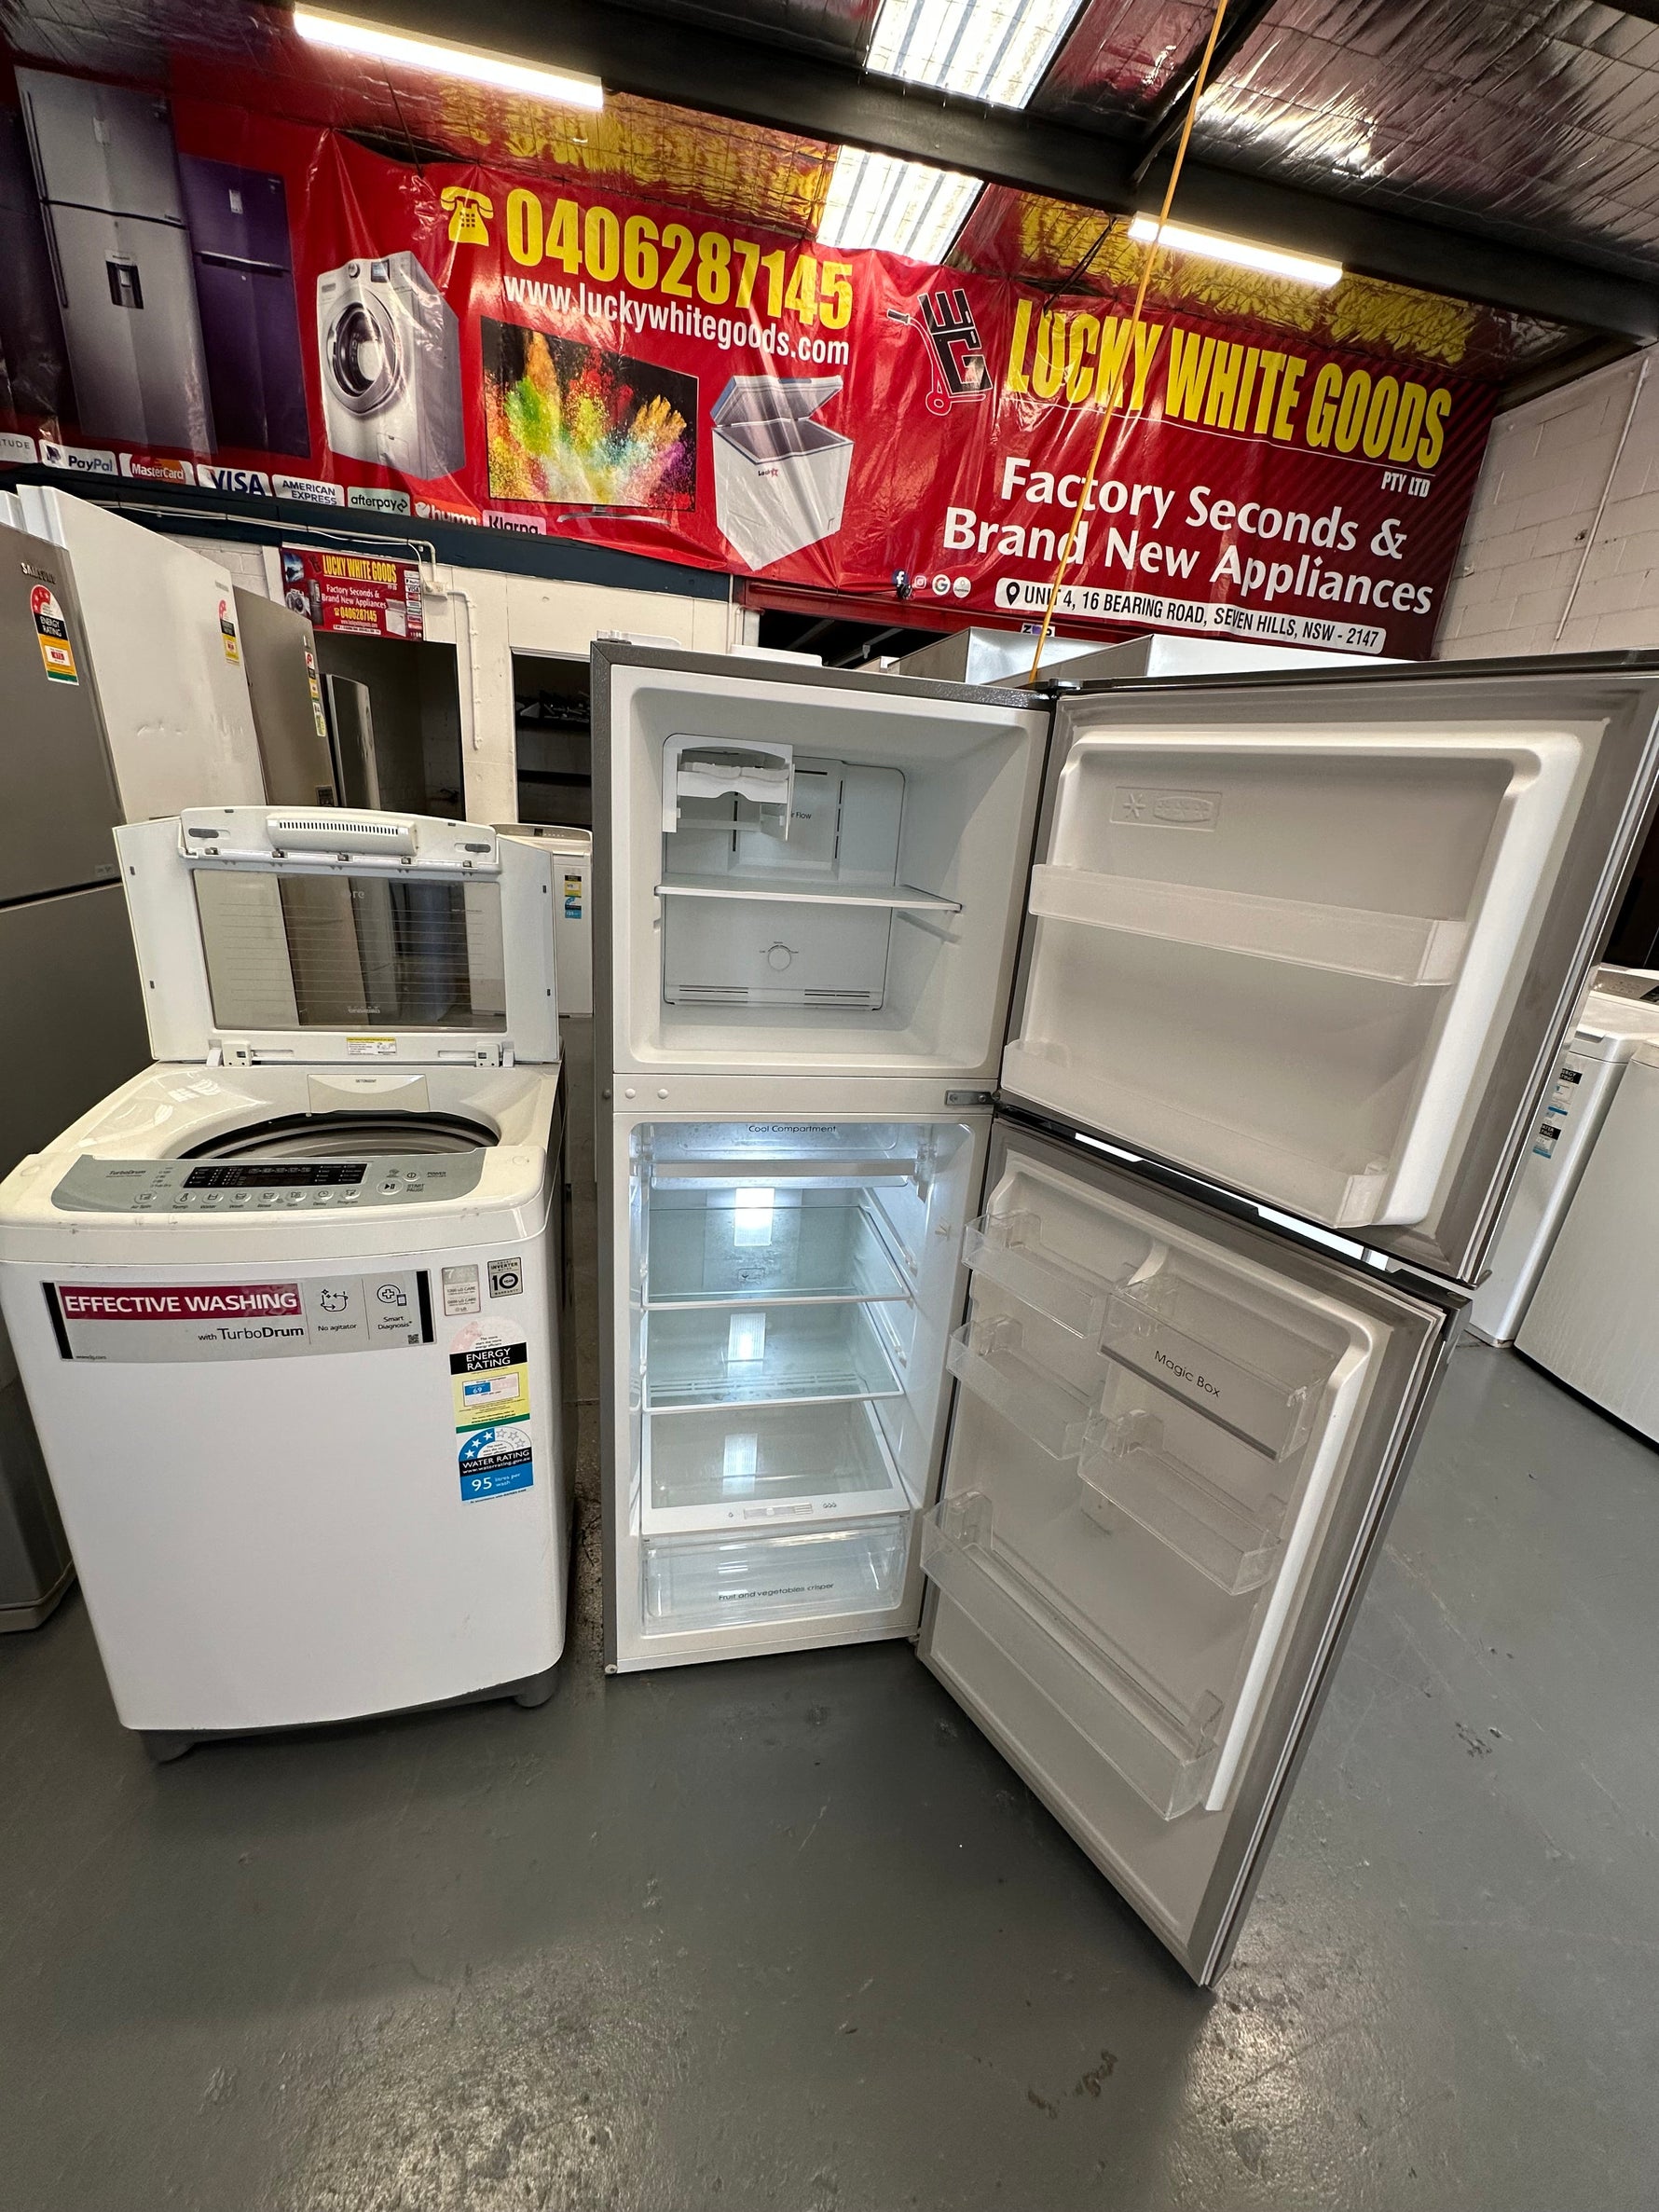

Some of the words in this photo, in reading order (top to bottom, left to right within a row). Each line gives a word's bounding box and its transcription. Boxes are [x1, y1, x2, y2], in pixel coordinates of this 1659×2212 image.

[506, 188, 853, 330] 0406287145
[503, 275, 850, 365] www.luckywhitegoods.com
[1006, 298, 1164, 411] LUCKY
[1165, 327, 1307, 441] WHITE
[1306, 363, 1451, 469] GOODS
[0, 438, 30, 449] TUDE
[68, 455, 113, 472] PayPal
[131, 463, 185, 480] MasterCard
[211, 470, 267, 495] VISA
[281, 479, 336, 496] AMERICAN
[1381, 471, 1406, 492] PTY
[1407, 476, 1431, 498] LTD
[291, 490, 337, 505] EXPRESS
[350, 495, 397, 512] afterpay
[430, 503, 477, 526] humm
[1001, 456, 1175, 529] Factory
[1186, 486, 1359, 551] Seconds
[1370, 518, 1407, 559] &
[943, 506, 1089, 565] Brand
[1104, 527, 1200, 580] New
[1209, 544, 1433, 614] Appliances
[322, 555, 346, 576] LUCKY
[347, 557, 372, 580] WHITE
[372, 561, 397, 584] GOODS
[326, 584, 349, 597] Factory
[350, 587, 374, 598] Seconds
[322, 593, 340, 603] Brand
[341, 596, 354, 605] New
[355, 598, 387, 610] Appliances
[340, 606, 377, 622] 0406287145
[1063, 590, 1076, 611] 4,
[1083, 591, 1100, 610] 16
[1104, 595, 1163, 618] BEARING
[1167, 602, 1208, 626] ROAD,
[1213, 607, 1254, 630] SEVEN
[1256, 614, 1297, 639] HILLS,
[1302, 621, 1336, 641] NSW
[1346, 627, 1379, 647] 2147
[796, 811, 812, 819] Flow
[772, 1125, 836, 1133] Compartment
[492, 1272, 519, 1291] 10
[64, 1295, 182, 1312] EFFECTIVE
[184, 1292, 297, 1312] WASHING
[198, 1332, 217, 1341] with
[217, 1326, 305, 1340] TurboDrum
[330, 1323, 357, 1332] agitator
[466, 1347, 512, 1363] ENERGY
[467, 1356, 511, 1371] RATING
[1155, 1350, 1194, 1382] Magic
[1197, 1376, 1221, 1397] Box
[462, 1457, 494, 1469] WATER
[496, 1449, 530, 1463] RATING
[462, 1457, 530, 1474] www.waterrating.gov.au
[472, 1477, 492, 1491] 95
[757, 1587, 805, 1597] vegetables
[807, 1583, 834, 1591] crisper
